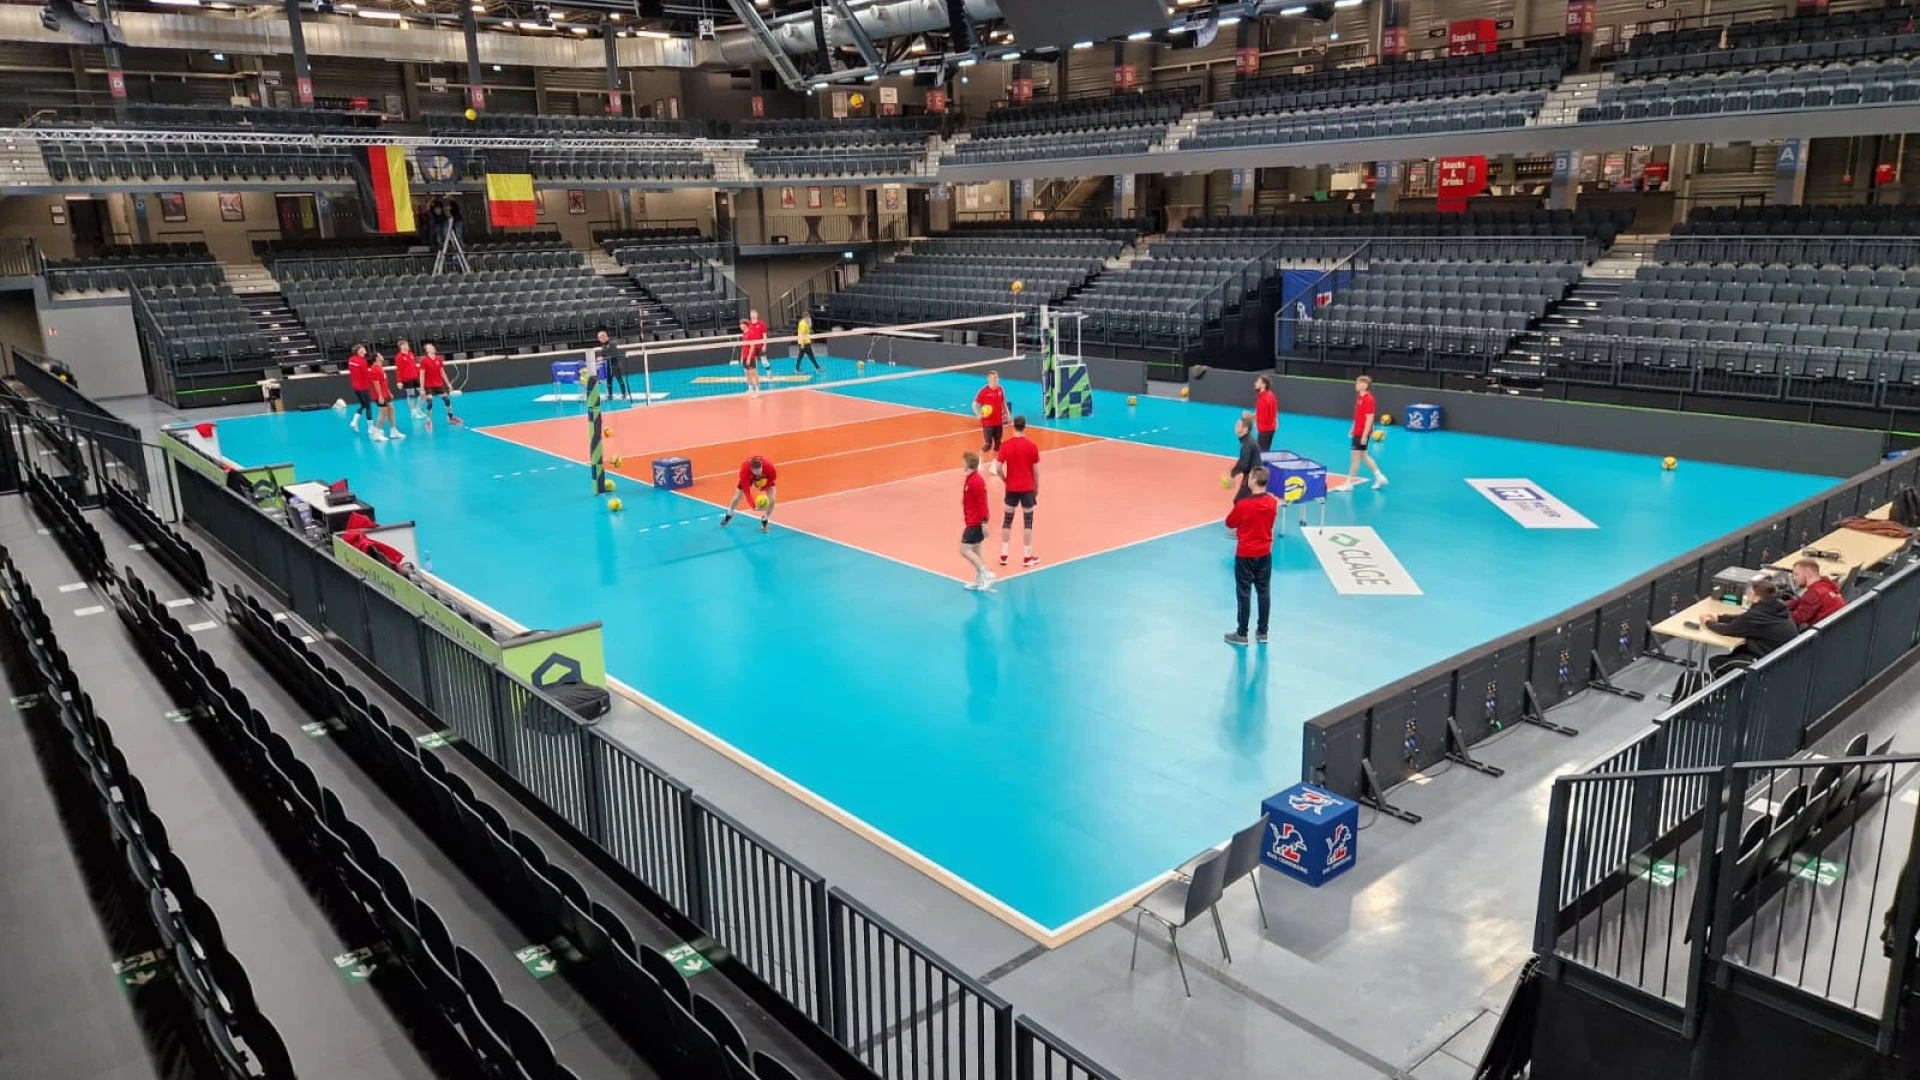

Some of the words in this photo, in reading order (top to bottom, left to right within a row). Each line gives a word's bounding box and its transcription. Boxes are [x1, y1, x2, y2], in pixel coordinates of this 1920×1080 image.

[1780, 146, 1795, 162] A
[1442, 160, 1467, 170] Snacks
[1556, 158, 1567, 170] B
[1441, 177, 1465, 187] Drinks
[1337, 549, 1392, 586] CLAGE
